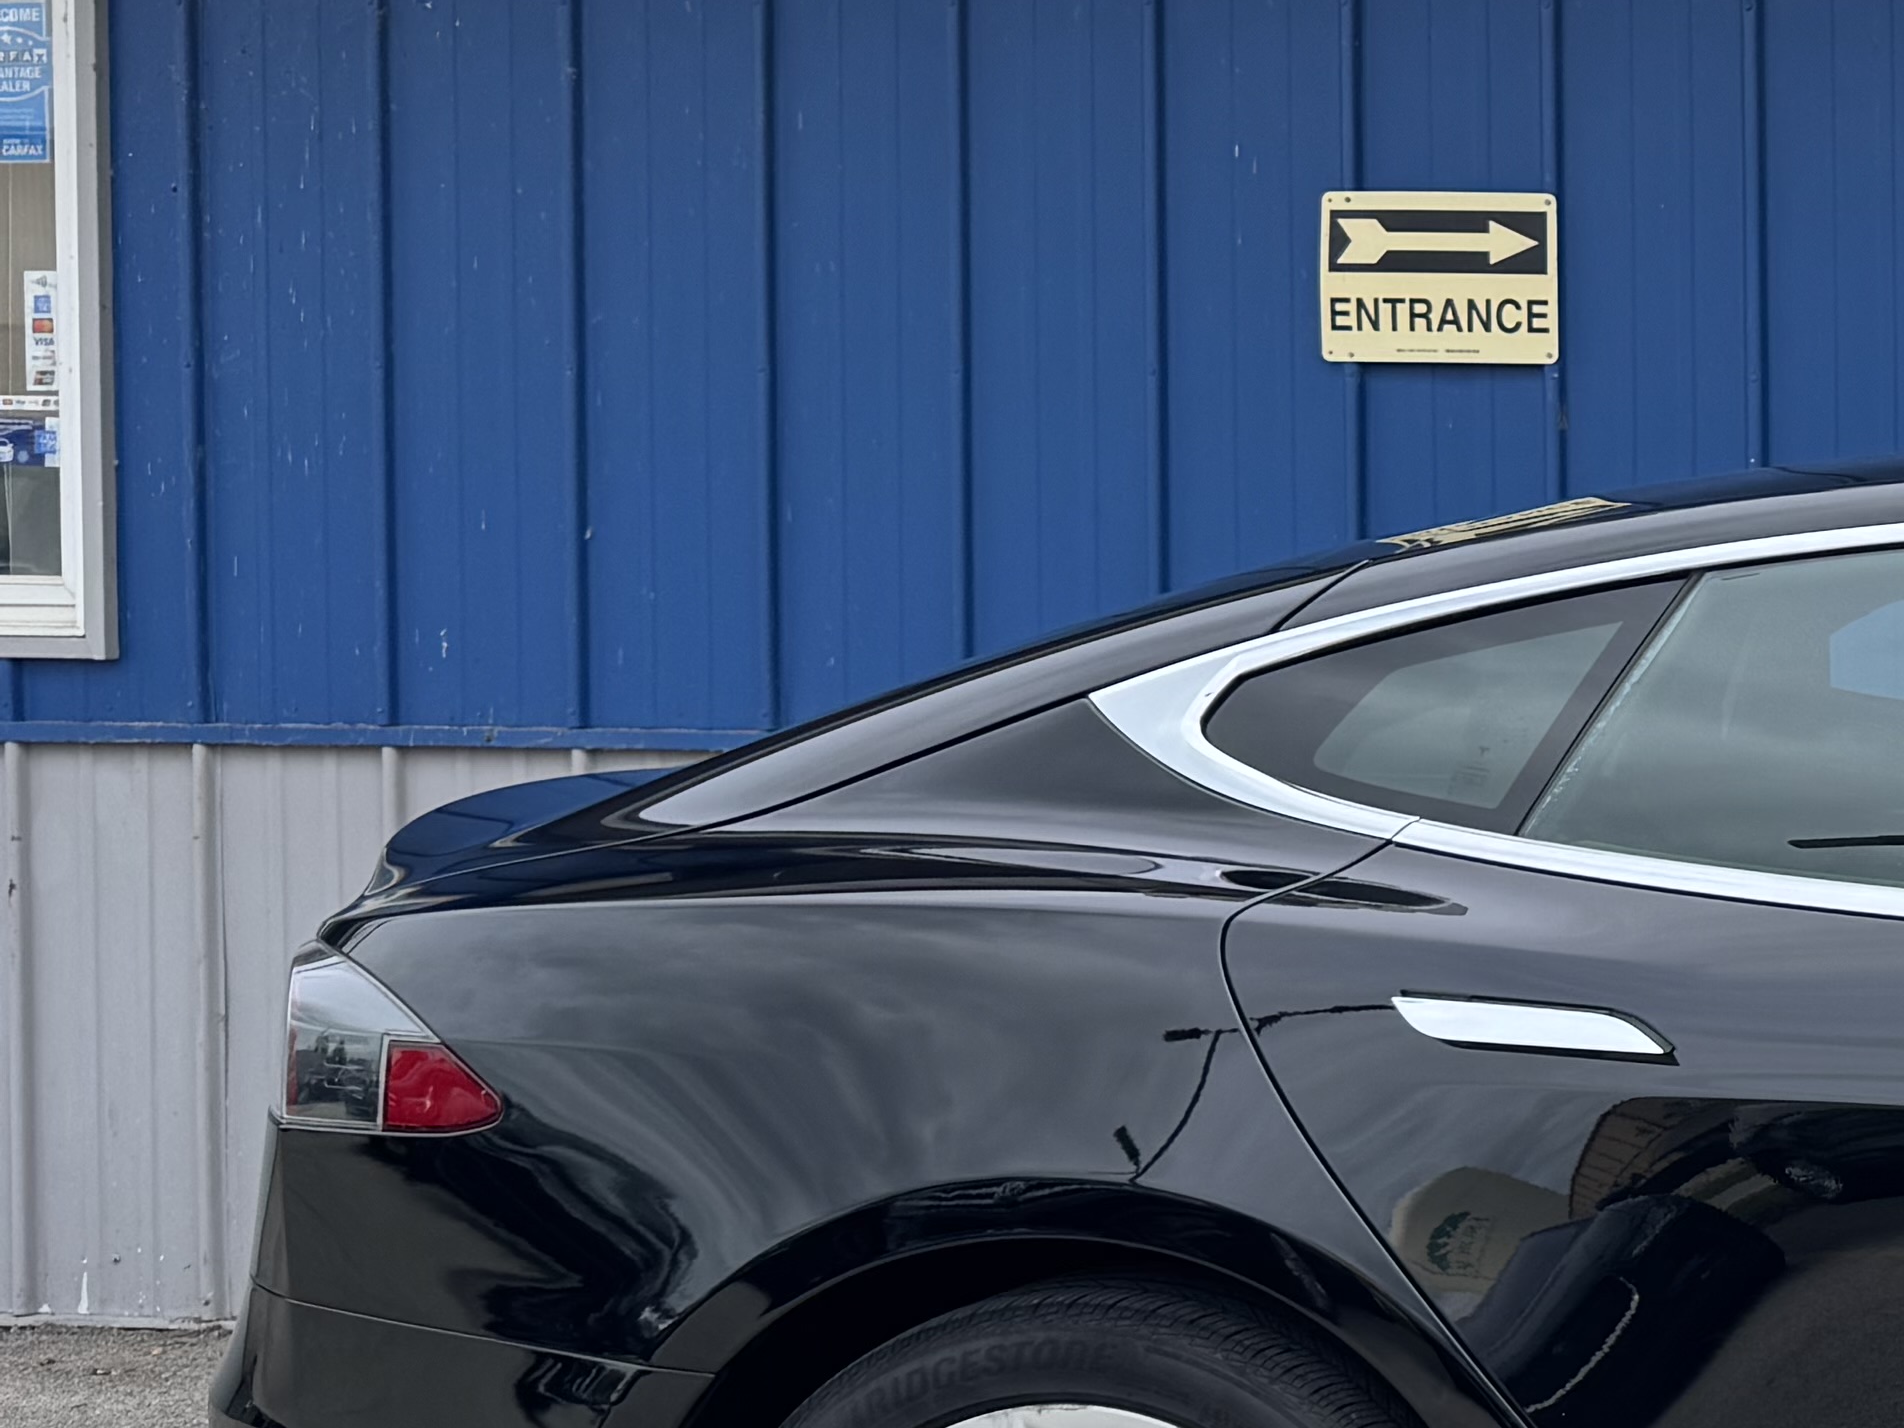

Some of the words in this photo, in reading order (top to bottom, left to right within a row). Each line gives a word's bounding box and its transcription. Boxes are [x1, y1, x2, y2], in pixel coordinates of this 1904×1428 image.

[0, 8, 40, 22] COME
[0, 80, 30, 92] ALER
[1329, 297, 1551, 333] ENTRANCE
[33, 337, 55, 346] VISA
